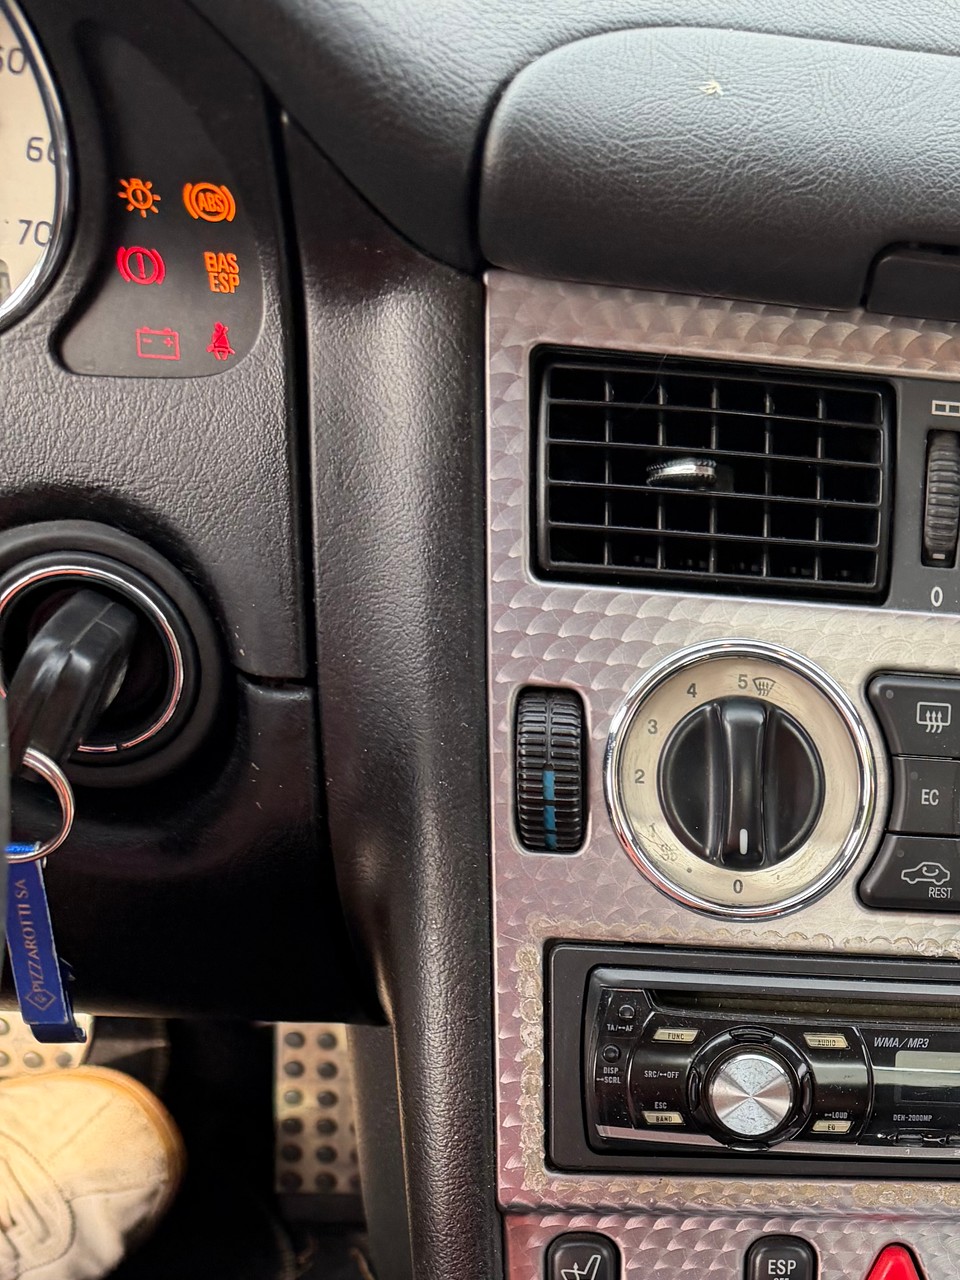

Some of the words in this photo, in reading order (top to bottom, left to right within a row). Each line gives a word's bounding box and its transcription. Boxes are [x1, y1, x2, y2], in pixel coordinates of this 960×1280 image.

[198, 191, 224, 212] ABS
[19, 219, 52, 247] 70
[204, 252, 239, 273] BAS
[208, 273, 240, 293] ESP
[737, 674, 748, 690] 5
[686, 683, 697, 698] 4
[648, 719, 658, 734] 3
[634, 769, 645, 784] 2
[921, 789, 939, 806] EC
[15, 878, 30, 899] SA
[733, 879, 744, 894] 0
[928, 887, 953, 899] REST
[16, 902, 45, 993] PIZZAROTTI
[667, 1032, 685, 1040] FUNC
[603, 1066, 619, 1074] DISP
[604, 1076, 621, 1084] SCRL
[654, 1101, 668, 1109] ESC
[655, 1115, 673, 1123] BAND
[831, 1111, 848, 1119] LOUD
[827, 1123, 836, 1131] EQ
[767, 1258, 797, 1276] ESP
